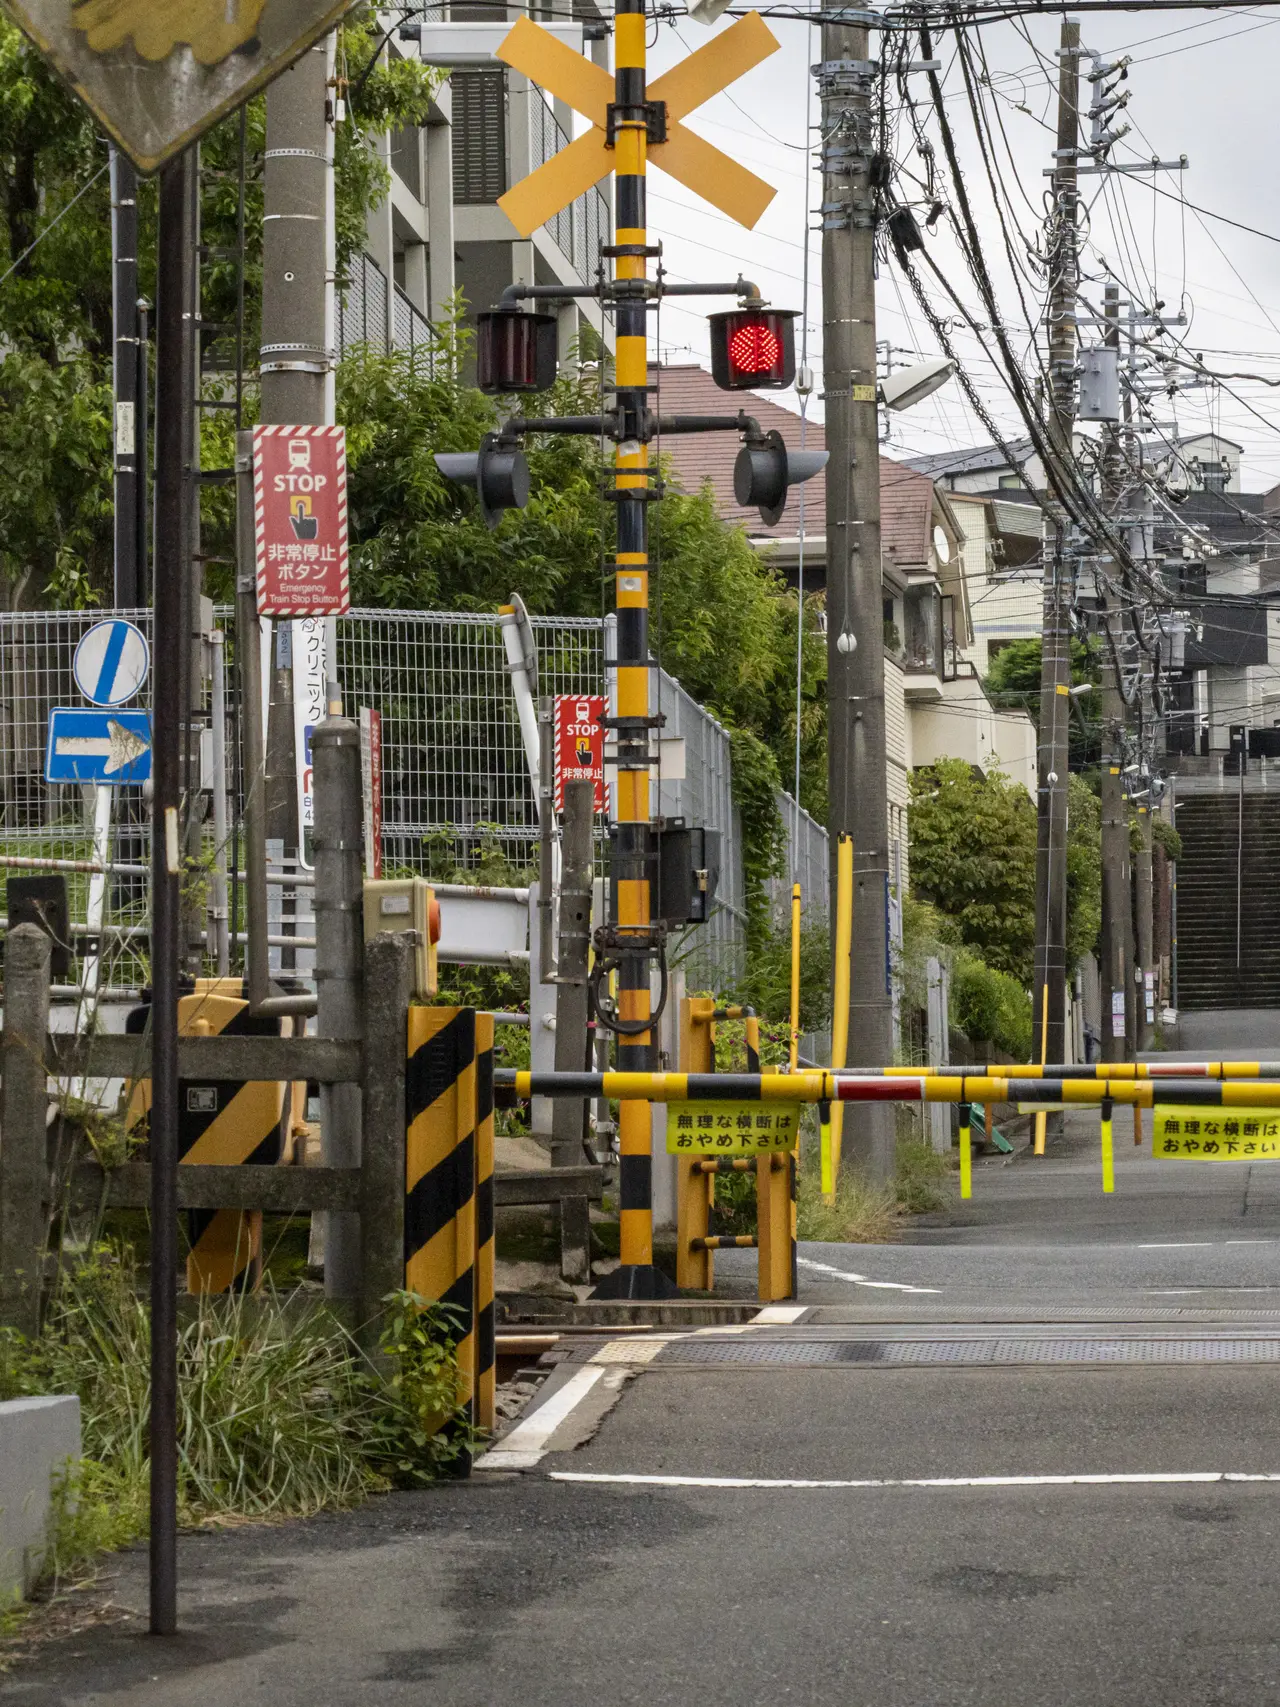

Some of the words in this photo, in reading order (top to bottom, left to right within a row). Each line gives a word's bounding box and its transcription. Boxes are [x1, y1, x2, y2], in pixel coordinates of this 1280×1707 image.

[274, 474, 327, 492] STOP
[268, 544, 336, 562] 非常停止
[278, 563, 328, 580] ボタン
[280, 584, 326, 594] Emergency
[269, 594, 290, 604] Train
[291, 594, 311, 606] Stop
[312, 594, 339, 604] Button
[307, 636, 320, 721] クリニック
[566, 724, 599, 736] STOP
[562, 768, 603, 780] 非常停止
[677, 1115, 792, 1129] 無理な横断は
[1164, 1120, 1279, 1137] 無理な横断は
[677, 1133, 789, 1147] おやめ下さい
[1163, 1138, 1276, 1154] おやめ下さい
